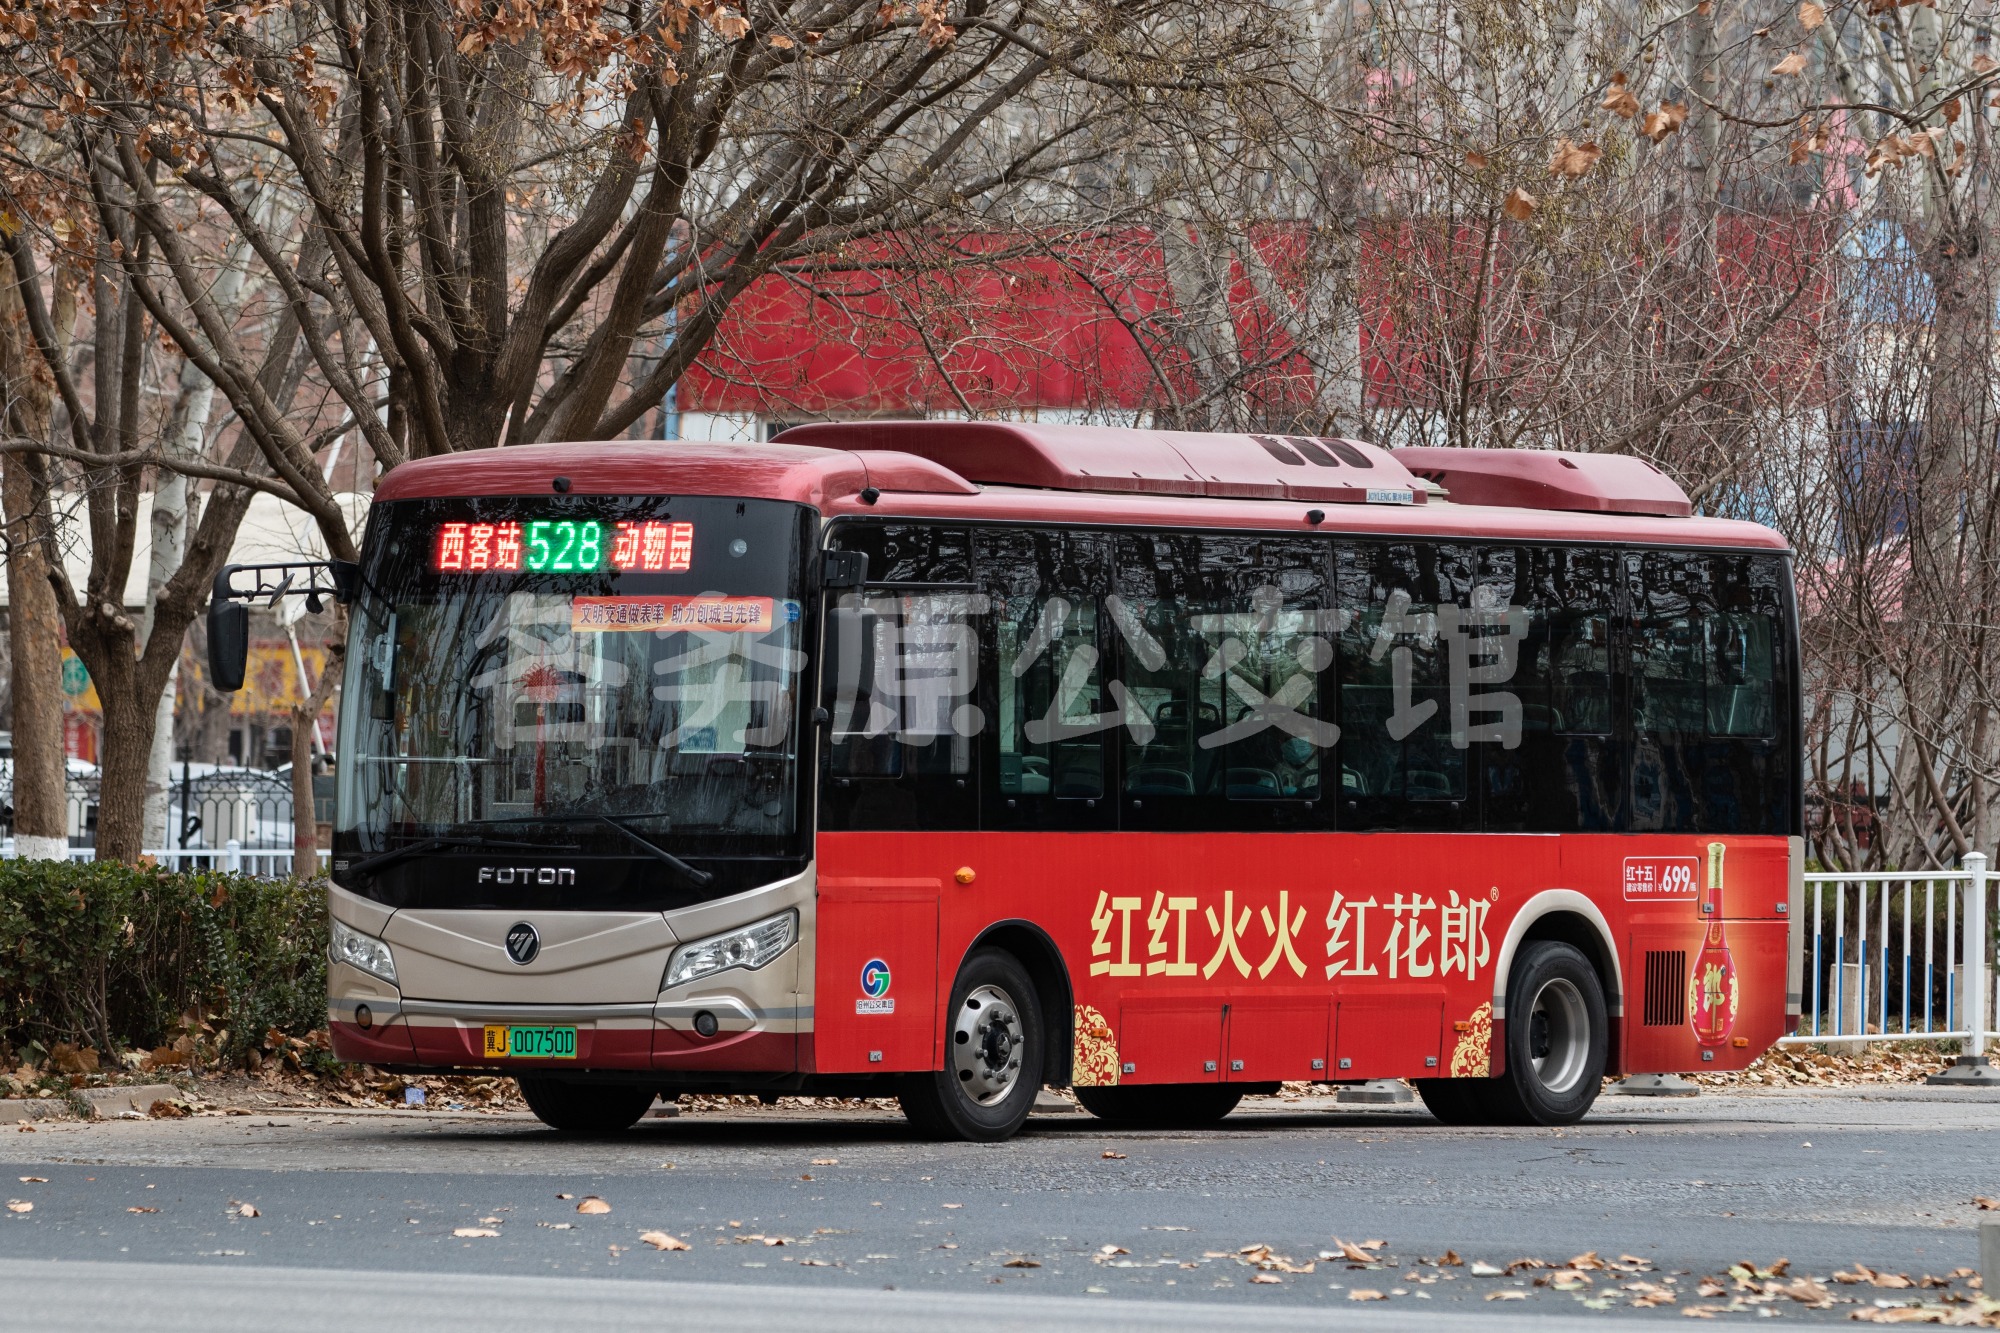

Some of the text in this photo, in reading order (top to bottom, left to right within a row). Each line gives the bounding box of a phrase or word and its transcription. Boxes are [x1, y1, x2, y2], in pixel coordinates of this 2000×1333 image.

[440, 522, 521, 569] 西客站
[528, 521, 601, 570] 528
[580, 604, 761, 624] 文明交通做表率 助力创城当先锋
[478, 867, 576, 886] FOTON
[1626, 866, 1653, 881] 红十五
[1089, 890, 1308, 981] 红红火火
[857, 1000, 893, 1009] 沧州公交集团
